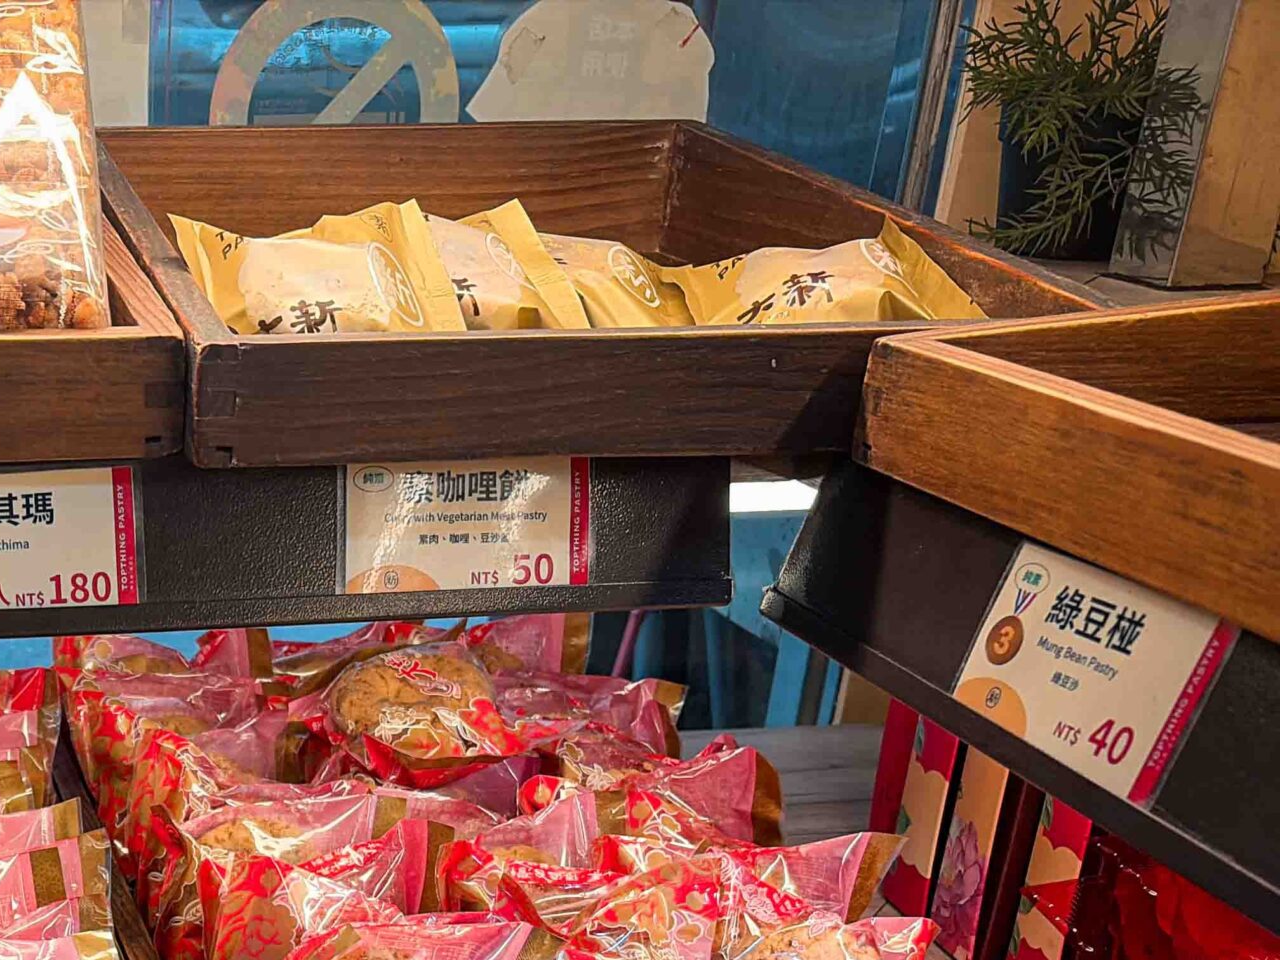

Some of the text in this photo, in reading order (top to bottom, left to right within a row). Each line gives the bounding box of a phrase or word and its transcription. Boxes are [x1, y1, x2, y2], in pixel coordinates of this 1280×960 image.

[117, 484, 128, 592] TOPTHING PASTRY
[437, 511, 489, 524] Vegetarian
[517, 511, 548, 522] Pastry
[573, 472, 581, 572] TOPTHING PASTRY
[15, 592, 45, 607] NT$
[49, 571, 112, 605] 180
[470, 570, 499, 586] NT$
[511, 553, 554, 585] 50
[993, 625, 1016, 655] 3
[1045, 585, 1147, 656] 綠豆椪
[1037, 635, 1119, 681] Mung Bean Pastry
[1186, 639, 1221, 693] PASTRY
[1052, 720, 1081, 747] NT$
[1088, 718, 1135, 765] 40
